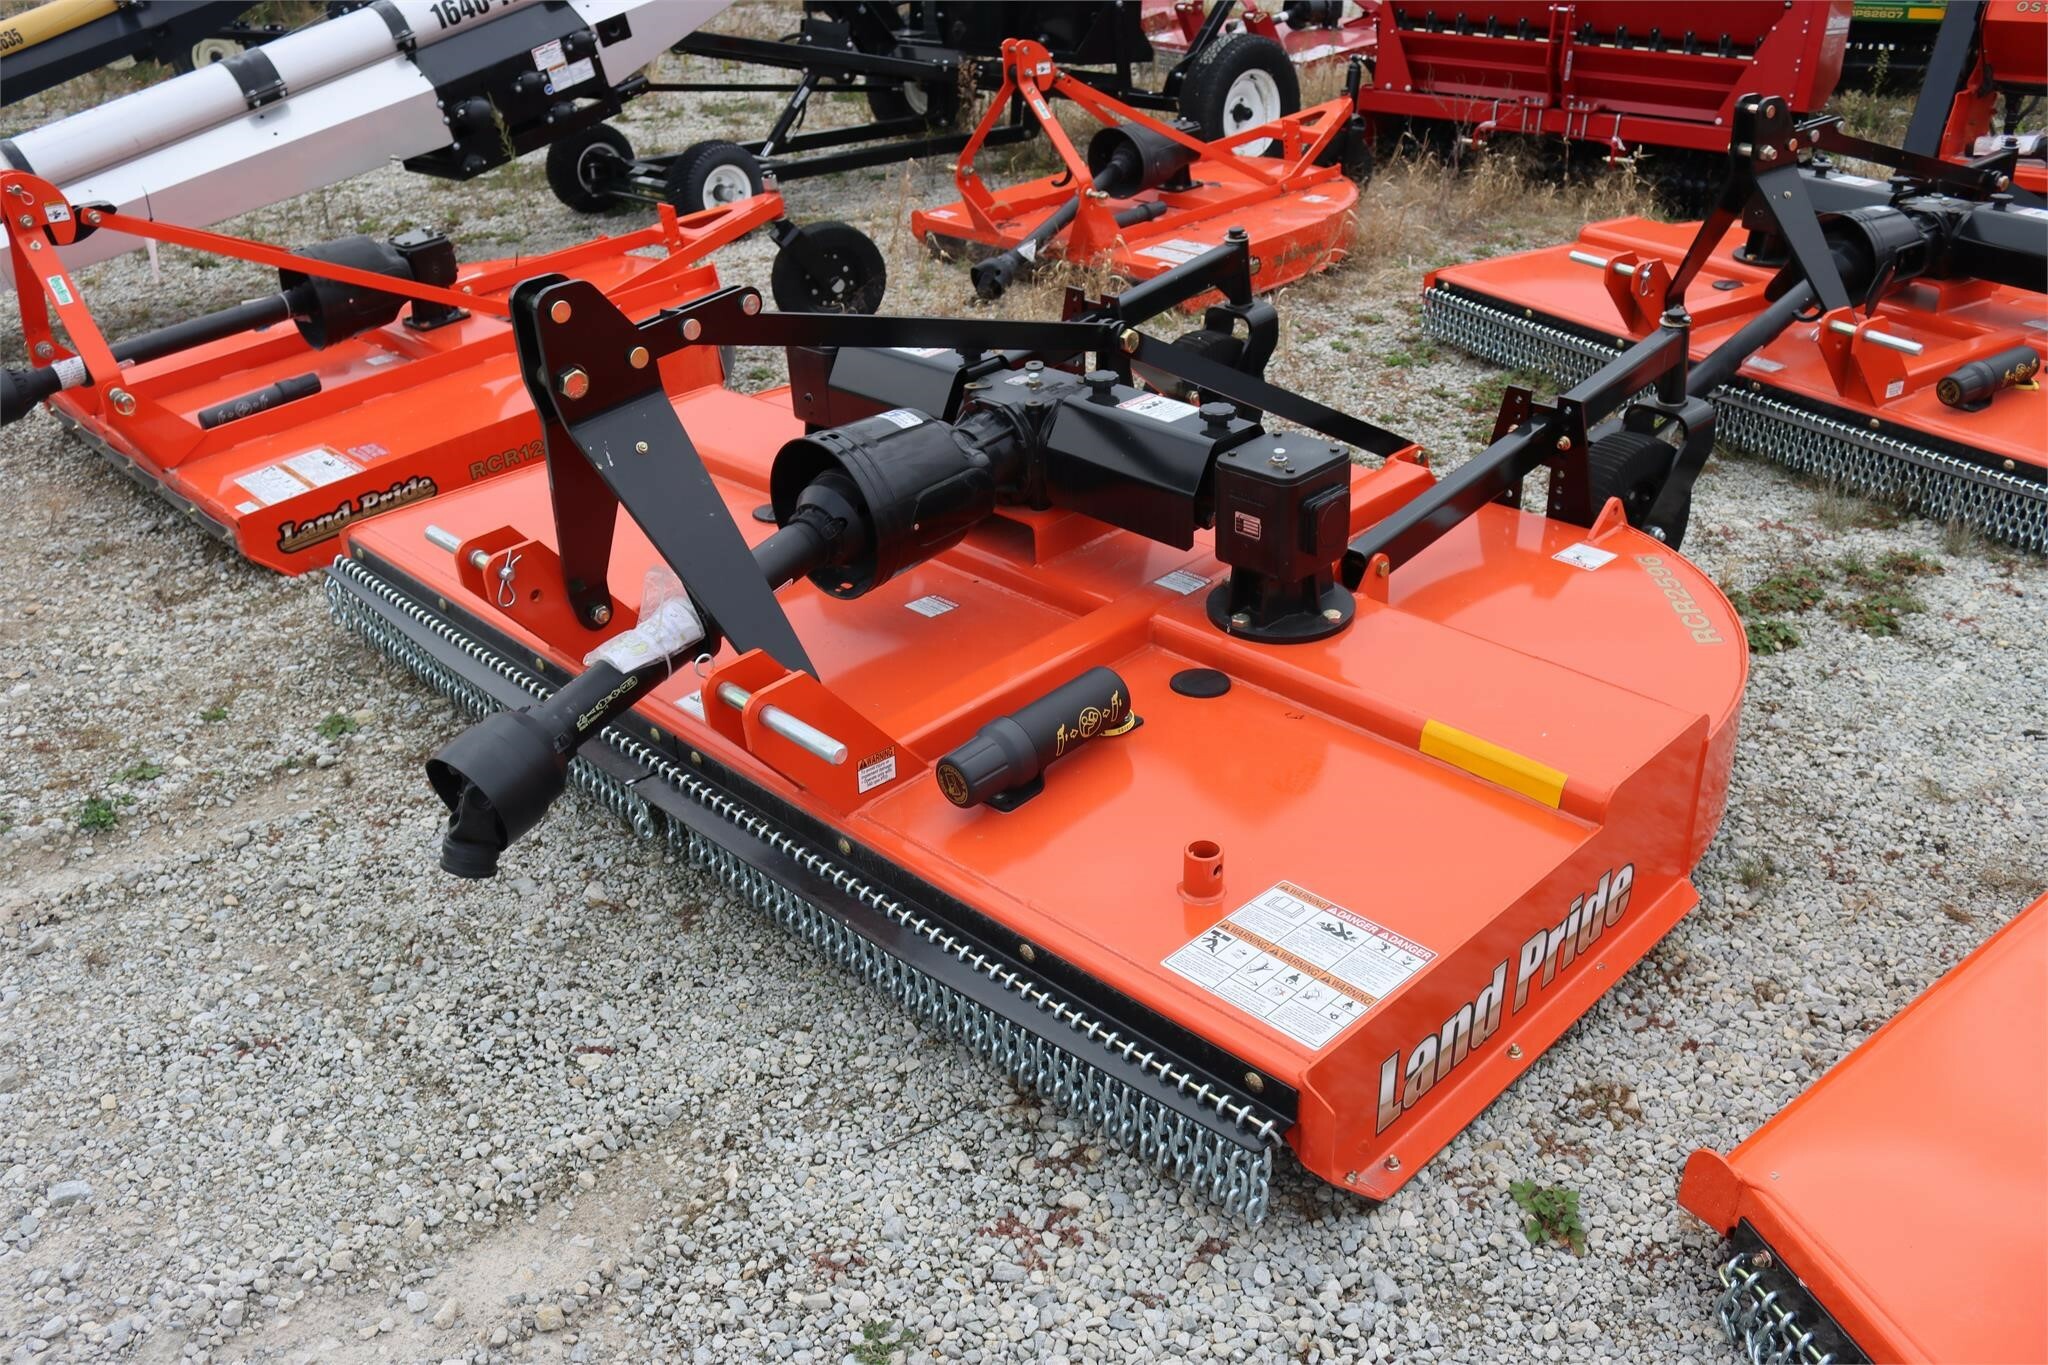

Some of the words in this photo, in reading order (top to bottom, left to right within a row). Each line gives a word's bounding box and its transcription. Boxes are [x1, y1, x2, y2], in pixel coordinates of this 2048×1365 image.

[280, 500, 351, 548] Land
[359, 476, 433, 516] Pride
[1636, 555, 1725, 644] RCR2596
[1290, 886, 1327, 910] WARNING
[1337, 909, 1379, 934] DANGER
[1231, 926, 1270, 951] WARNING
[1387, 933, 1432, 960] DANGER
[1280, 952, 1320, 977] WARNING
[1332, 981, 1374, 1006] WARNING
[1376, 958, 1509, 1136] Land
[1512, 863, 1634, 1017] Pride
